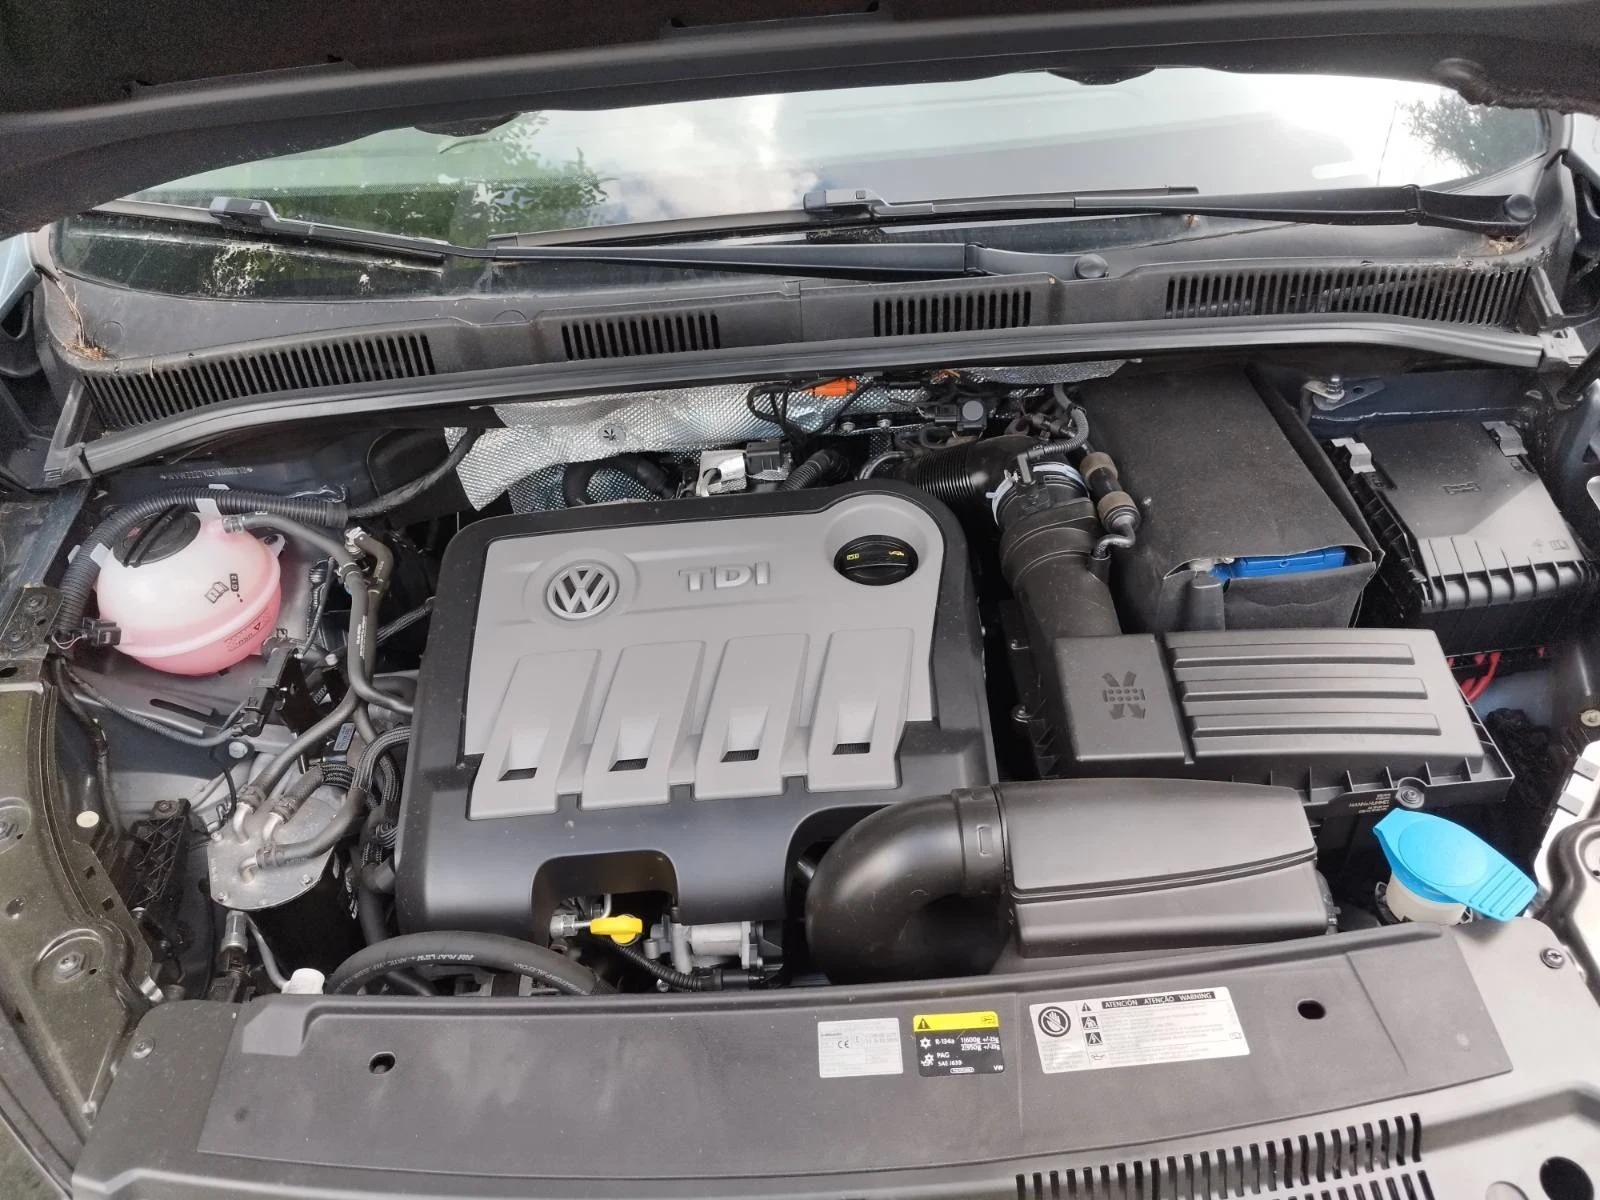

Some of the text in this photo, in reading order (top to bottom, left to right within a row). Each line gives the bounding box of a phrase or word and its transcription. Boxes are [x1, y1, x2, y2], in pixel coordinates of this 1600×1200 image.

[679, 561, 770, 592] TDI
[1104, 991, 1212, 1009] ATENCIÓN ATENÇÃO WARNING
[936, 1051, 950, 1059] PAG
